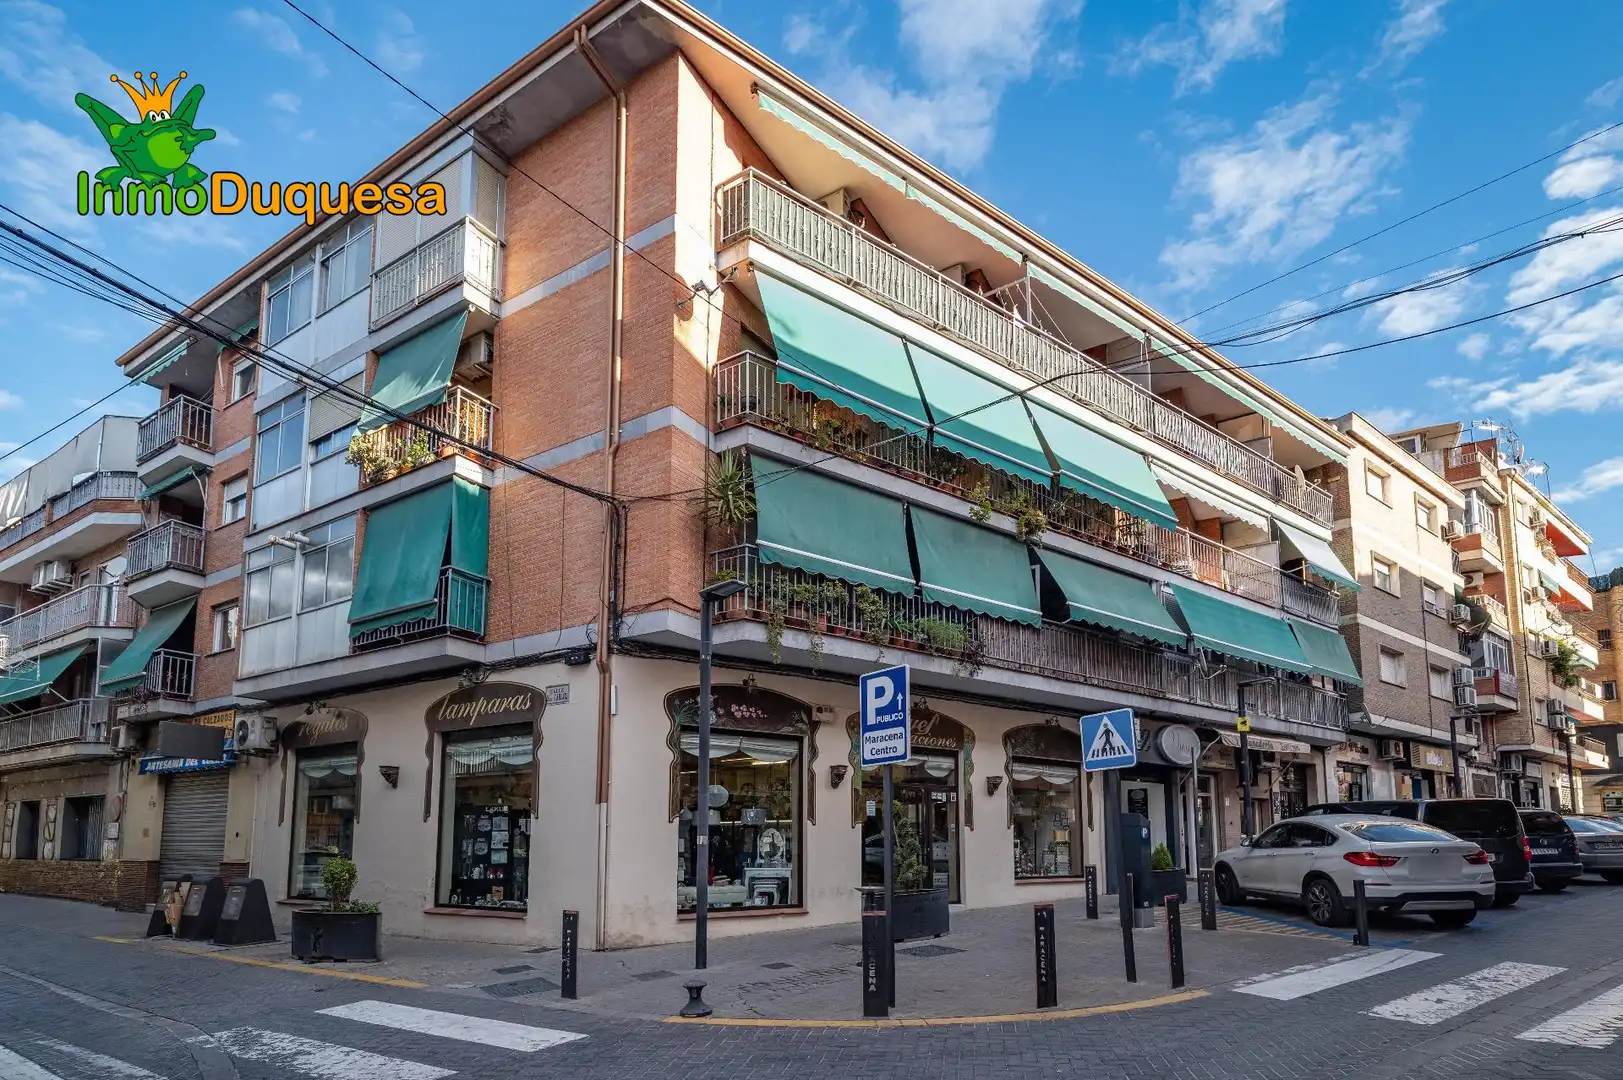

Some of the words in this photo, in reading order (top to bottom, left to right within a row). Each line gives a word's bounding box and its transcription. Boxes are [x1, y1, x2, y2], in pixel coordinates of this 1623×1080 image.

[867, 676, 895, 725] P
[203, 713, 233, 724] CALZADOS
[876, 712, 904, 724] PUBLICO
[864, 732, 904, 745] Maracena
[870, 745, 898, 756] Centro
